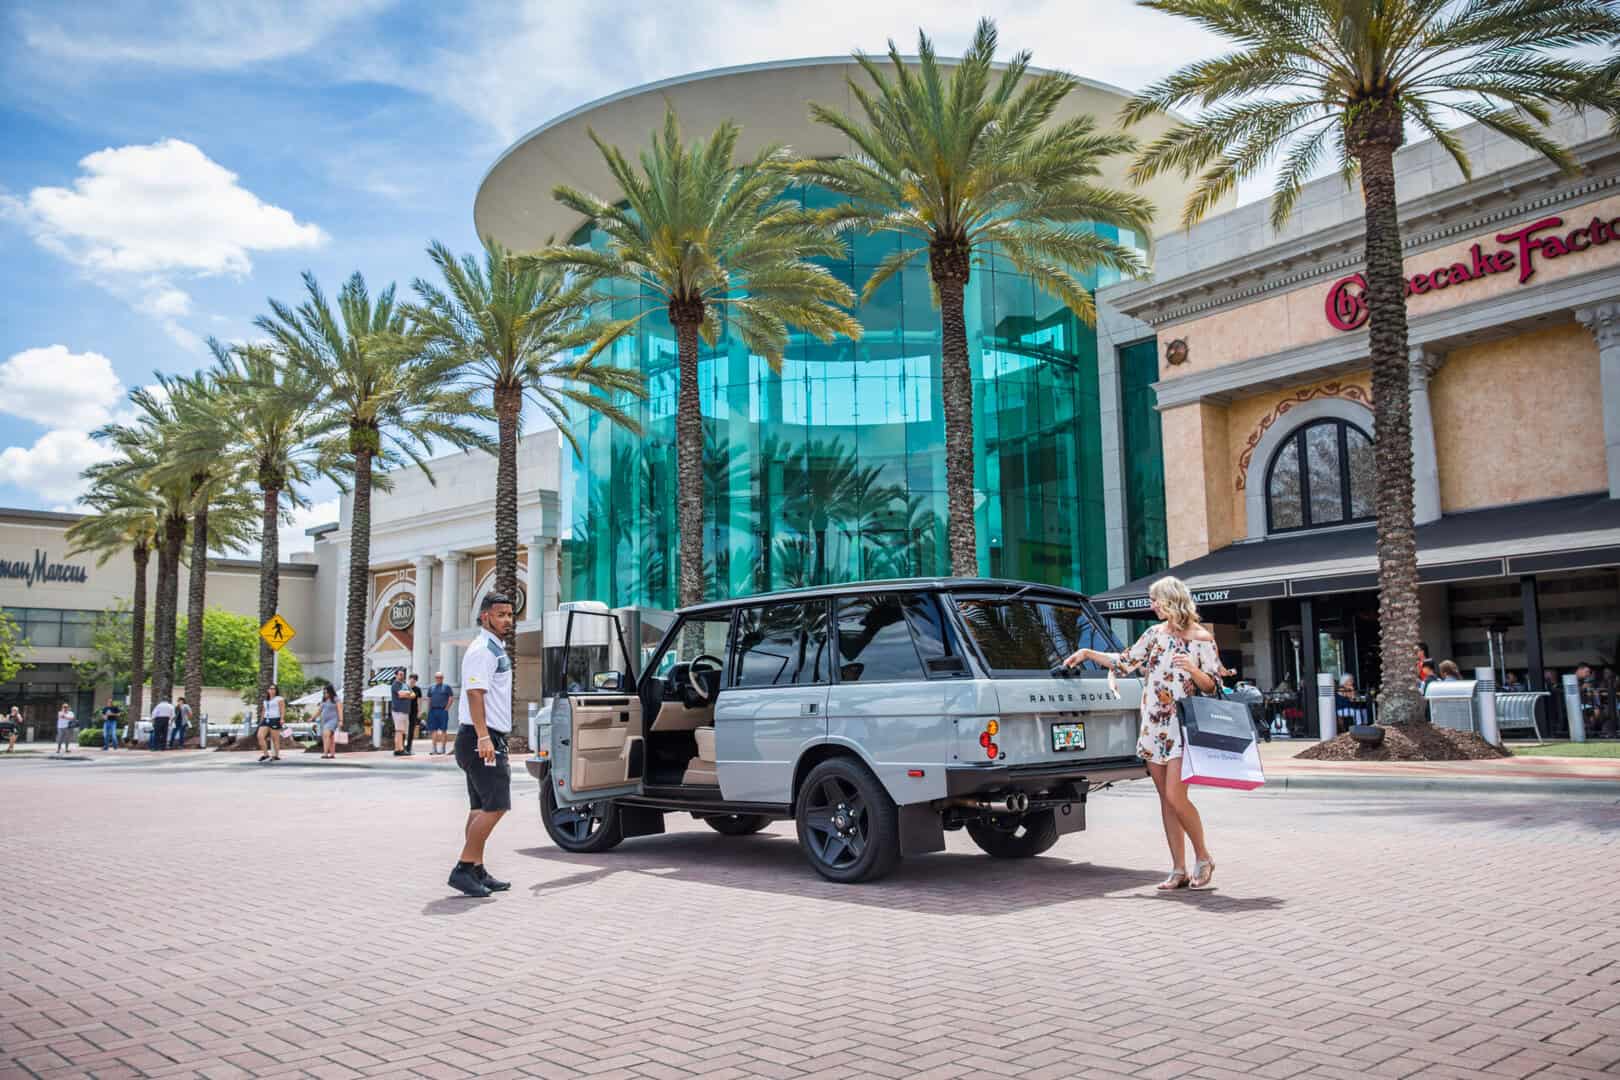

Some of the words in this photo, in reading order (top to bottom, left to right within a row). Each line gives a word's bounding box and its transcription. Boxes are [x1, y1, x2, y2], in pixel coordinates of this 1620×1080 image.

[27, 549, 88, 587] Marcus
[1107, 601, 1125, 610] THE
[1192, 590, 1230, 602] ACTORY
[1029, 694, 1073, 702] RANGE
